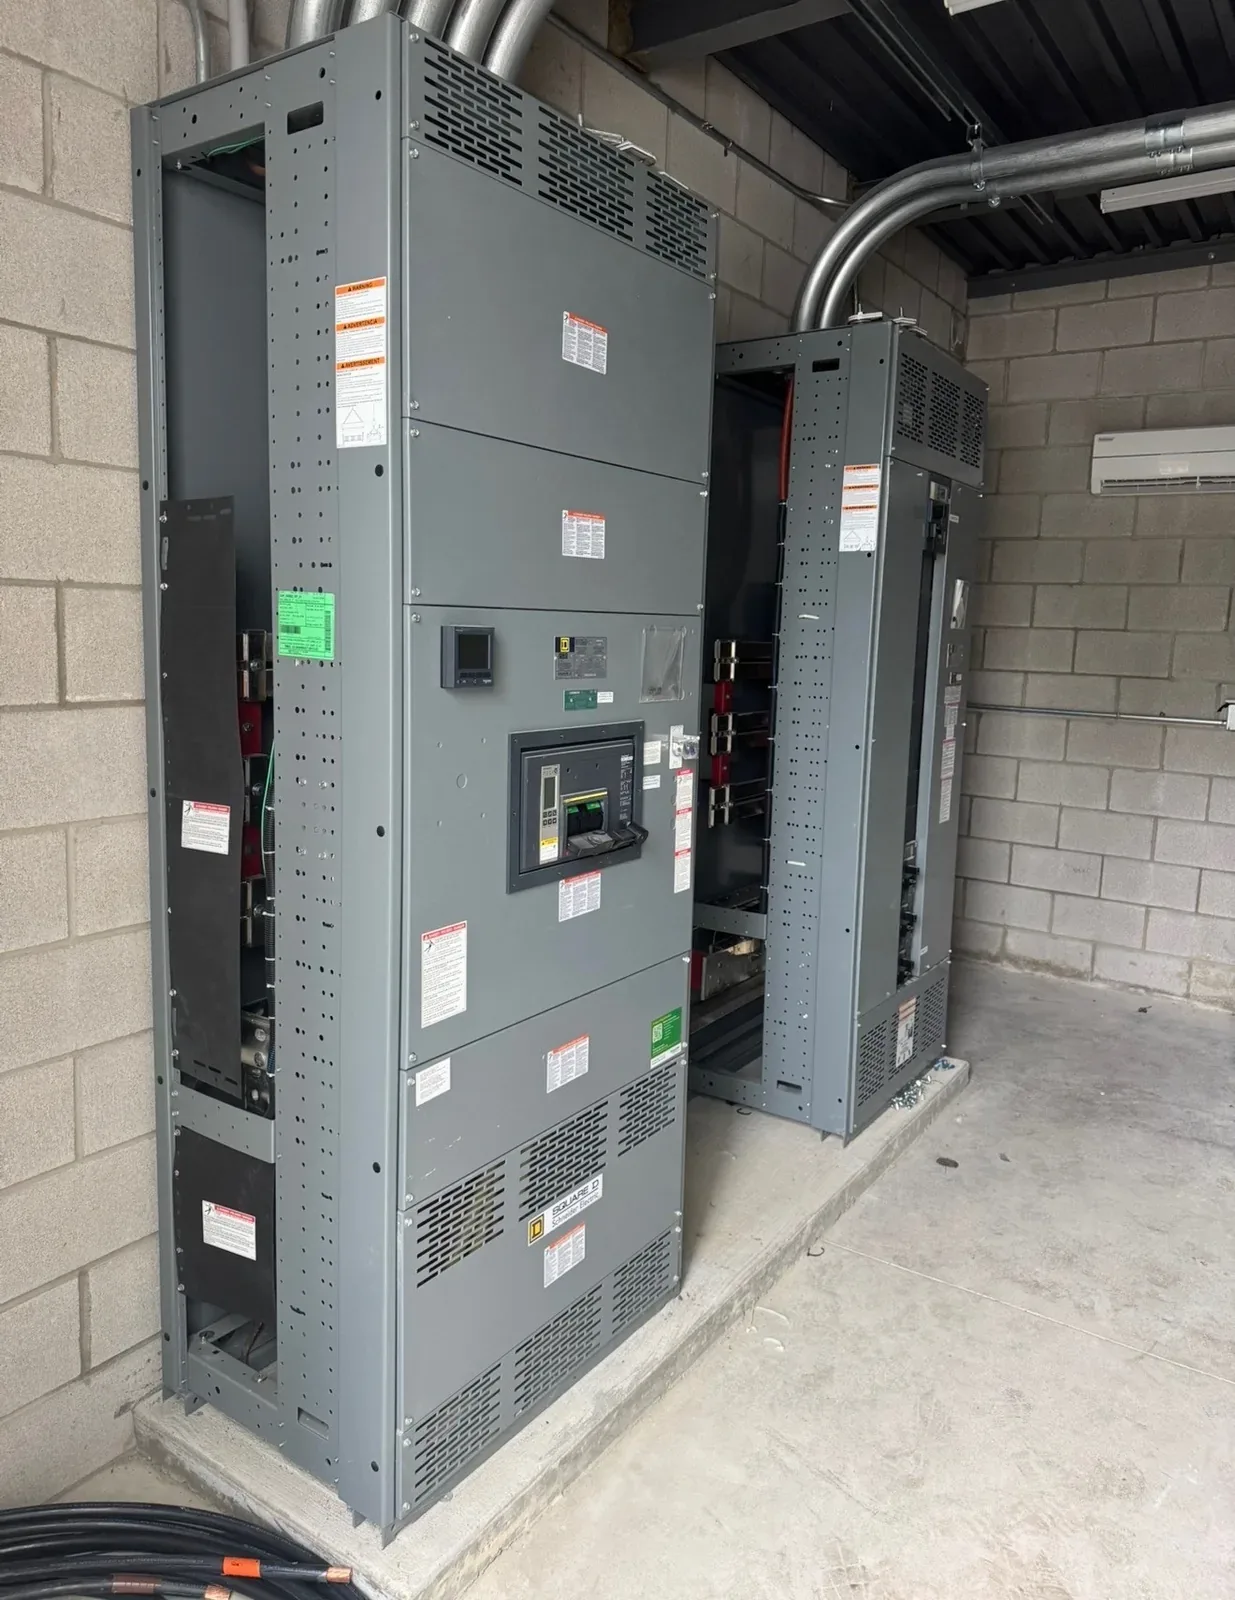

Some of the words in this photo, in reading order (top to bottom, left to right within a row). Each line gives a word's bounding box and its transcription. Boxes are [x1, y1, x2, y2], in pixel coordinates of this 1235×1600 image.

[352, 282, 373, 291] WARNING
[347, 319, 378, 329] ADVERTENCIA
[344, 357, 380, 368] AVERTISSEMENT
[552, 1184, 589, 1216] SQUARE
[591, 1179, 599, 1189] D
[552, 1206, 579, 1228] Schneider
[579, 1192, 599, 1209] Electric
